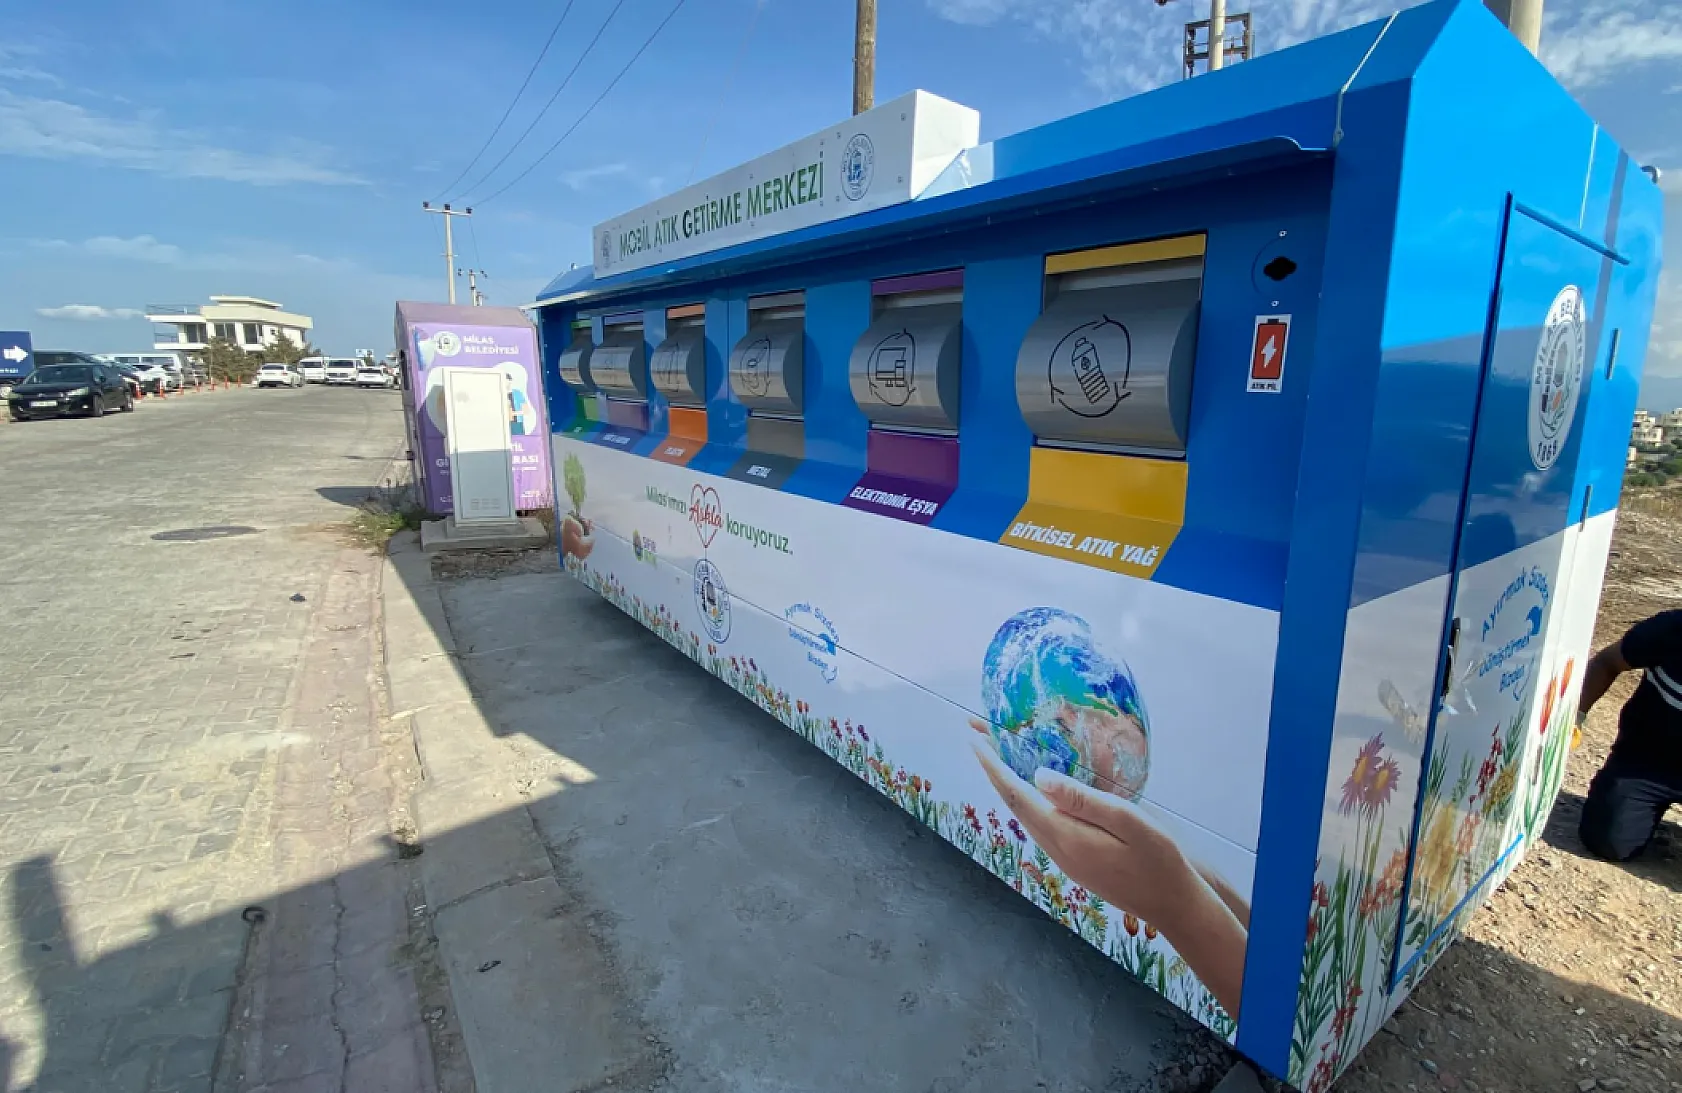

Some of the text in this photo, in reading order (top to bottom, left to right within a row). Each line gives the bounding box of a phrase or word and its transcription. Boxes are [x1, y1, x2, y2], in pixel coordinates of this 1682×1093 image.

[619, 219, 651, 258] MOBİL
[654, 214, 680, 247] ATIK
[682, 193, 742, 239] GETİRME
[747, 151, 823, 221] MERKEZİ
[850, 486, 938, 515] ELEKTRONİK EŞYA
[726, 512, 793, 555] koruyoruz.
[1009, 521, 1160, 567] BİTKİSEL ATIK YAĞ
